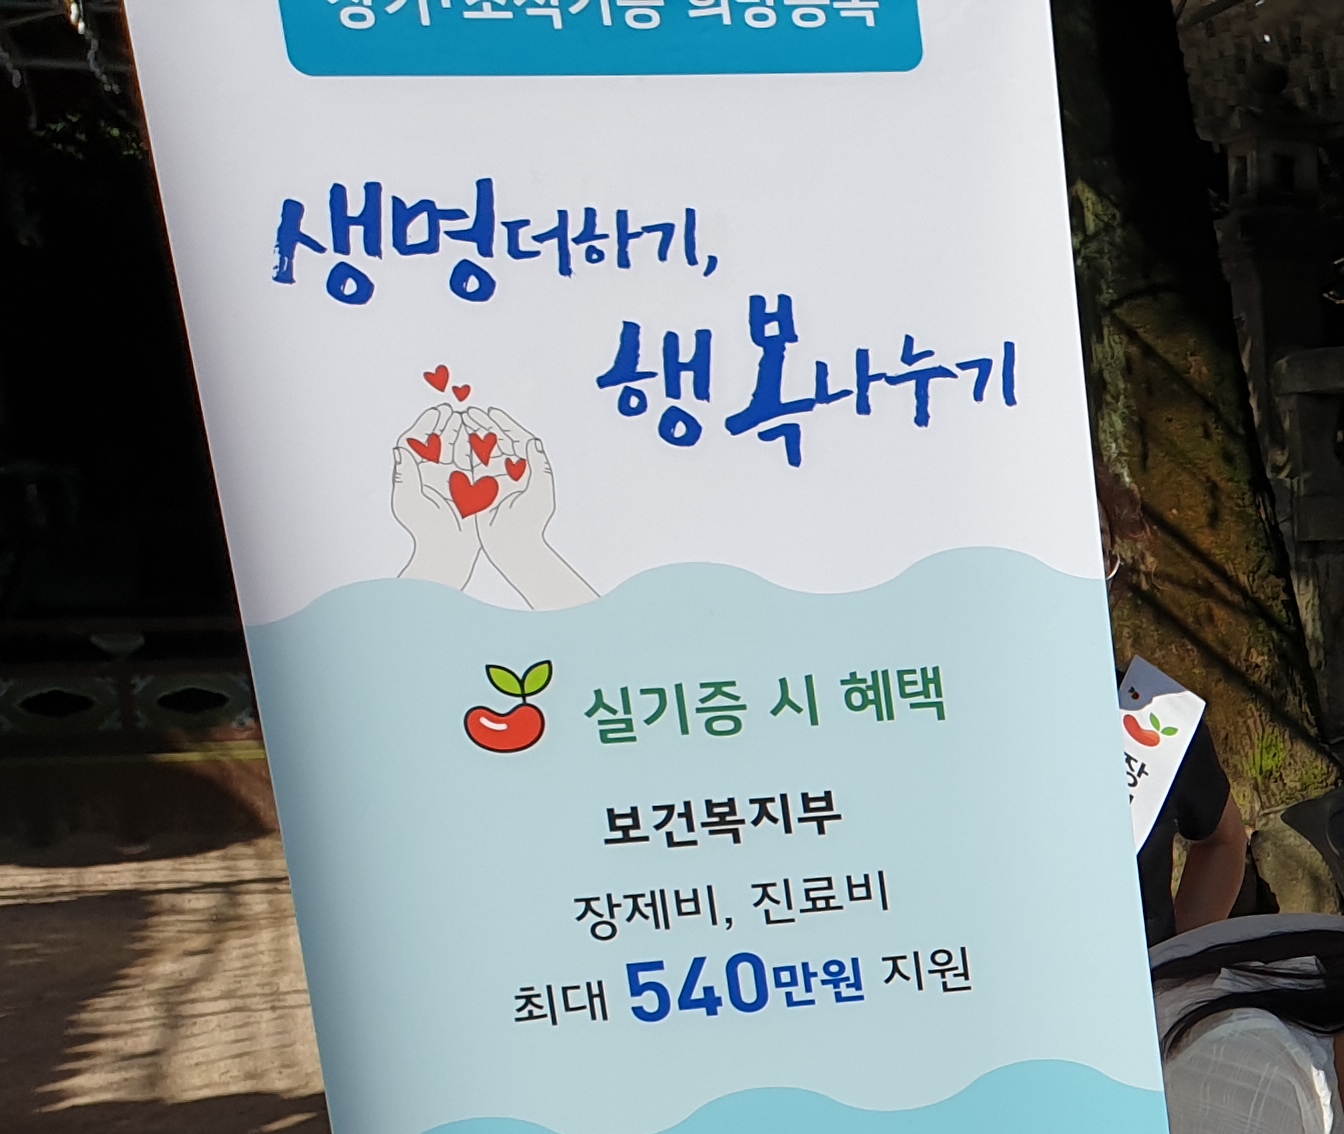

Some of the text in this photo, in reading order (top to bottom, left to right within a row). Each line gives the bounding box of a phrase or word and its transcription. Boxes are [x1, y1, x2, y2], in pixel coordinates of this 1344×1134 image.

[272, 178, 718, 305] 생명더하기,
[597, 294, 1018, 467] 행복나누기
[584, 664, 948, 745] 실기증 시 혜택
[602, 790, 843, 850] 보건복지부
[573, 870, 891, 943] 장제비, 진료비
[513, 946, 973, 1028] 최대 540만원 지원
